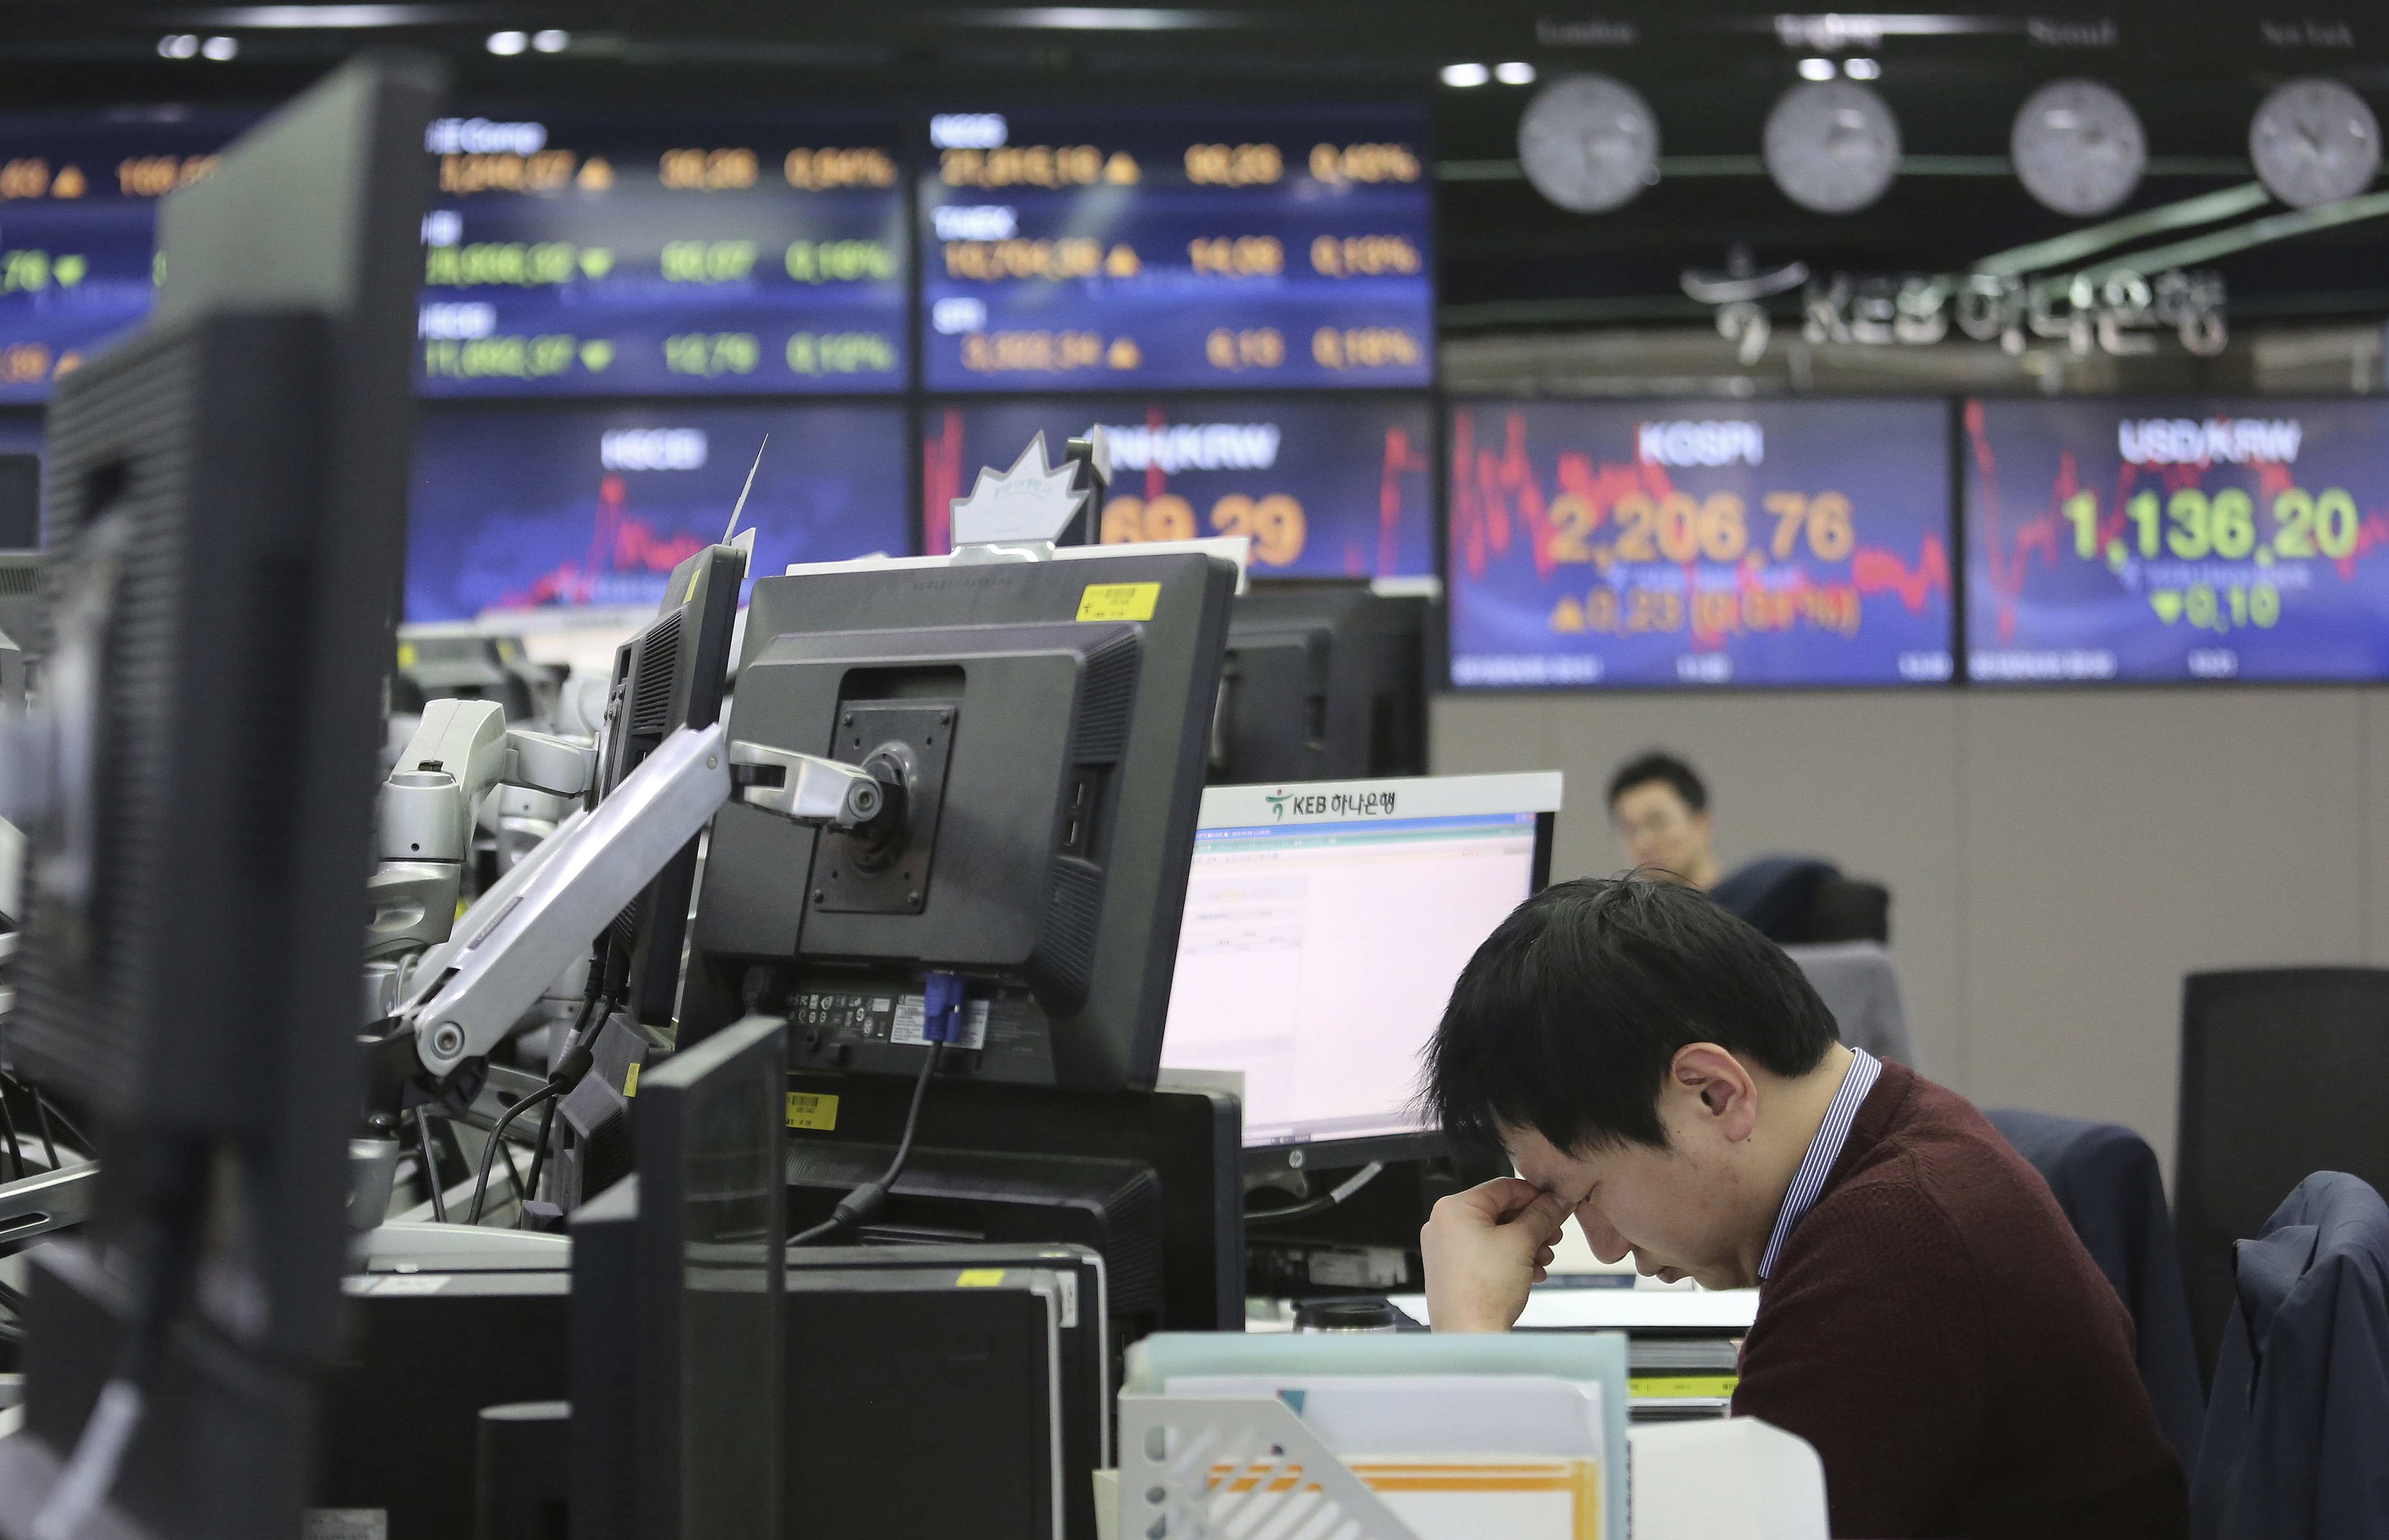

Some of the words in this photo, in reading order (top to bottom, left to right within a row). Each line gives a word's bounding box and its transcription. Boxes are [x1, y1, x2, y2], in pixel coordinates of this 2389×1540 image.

[1801, 273, 1949, 348] KEB
[1638, 420, 1764, 467] KOSPI
[2119, 417, 2302, 468] USD/KRW
[1292, 796, 1326, 815] KEB
[1331, 791, 1396, 816] 하나은행
